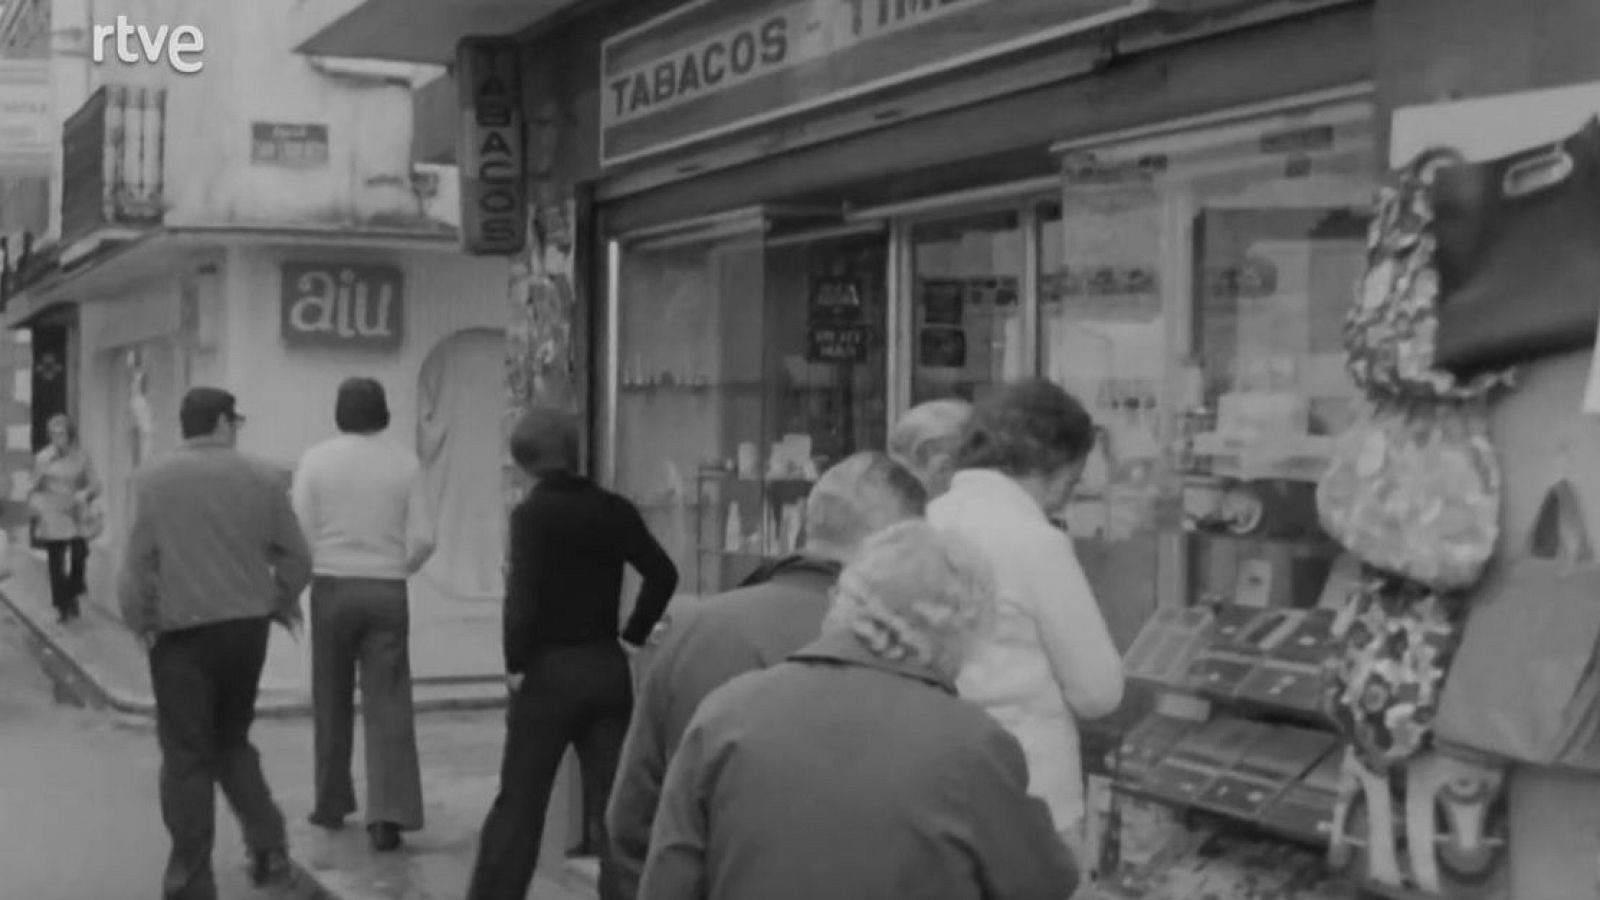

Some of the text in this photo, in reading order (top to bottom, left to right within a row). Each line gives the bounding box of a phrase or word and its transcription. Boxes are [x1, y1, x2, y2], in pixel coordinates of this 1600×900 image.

[611, 16, 788, 115] TABACOS
[842, 0, 956, 37] TI
[476, 47, 516, 243] TABACOS
[290, 267, 392, 338] aiu
